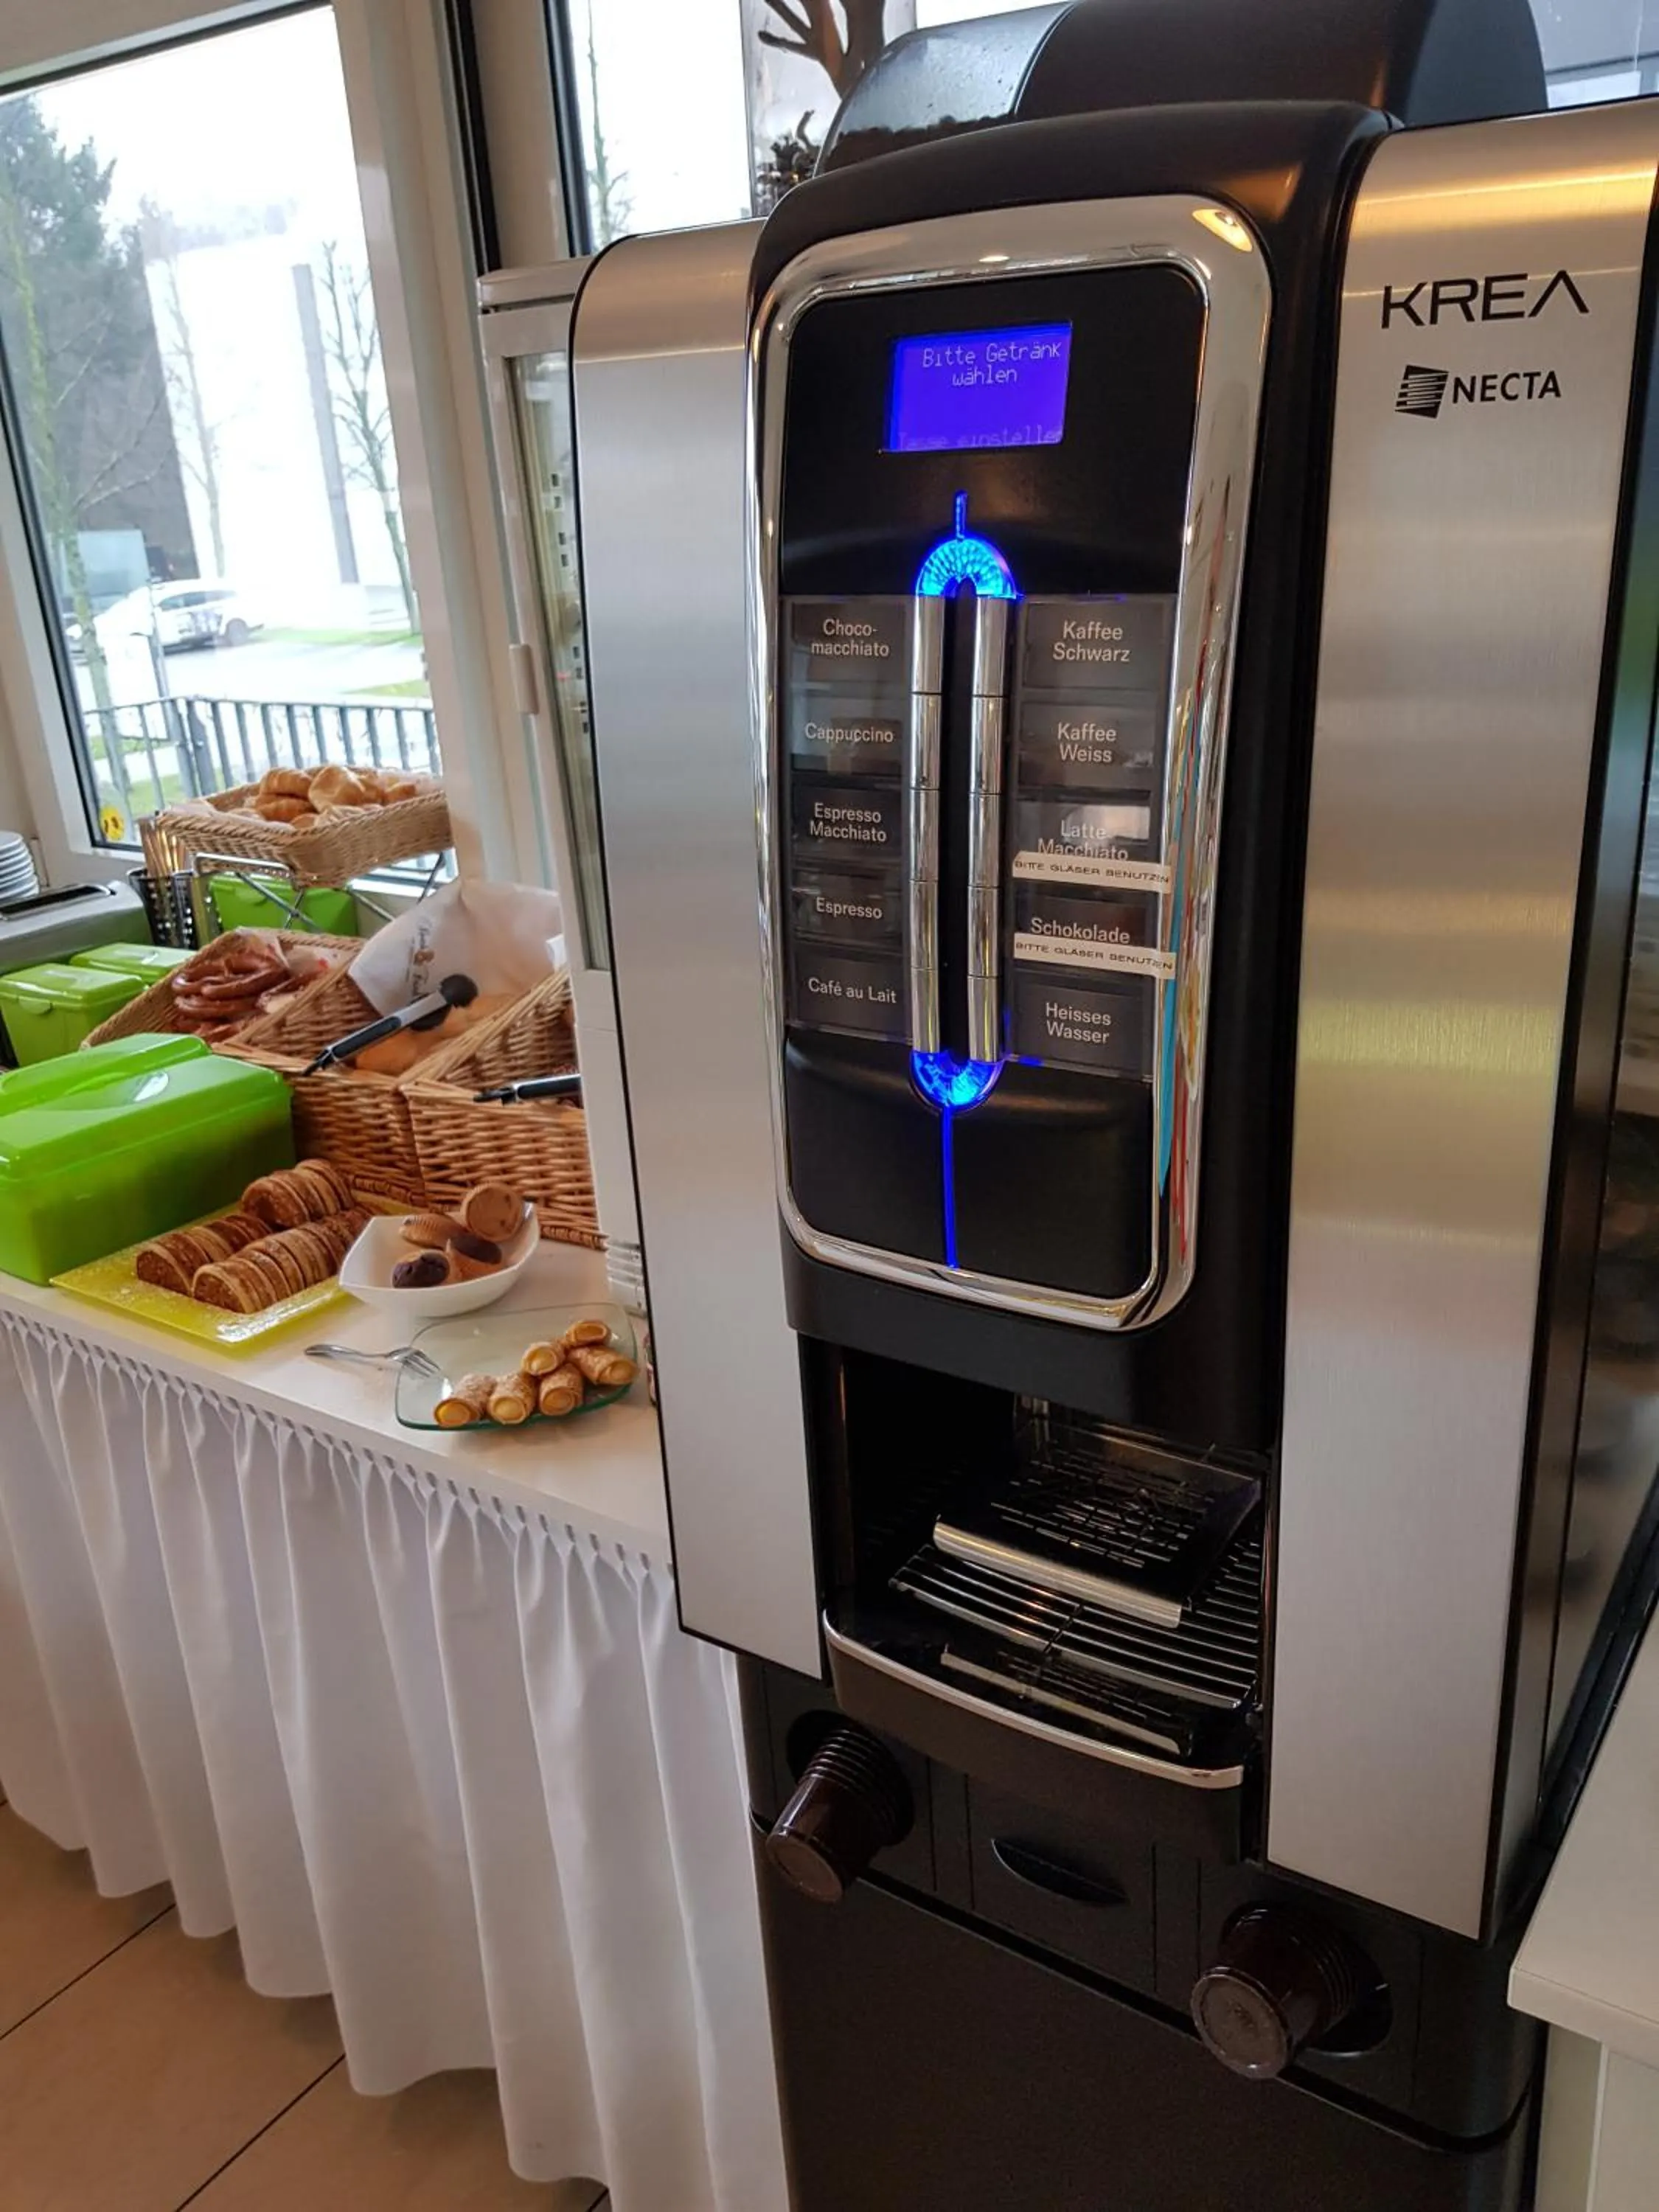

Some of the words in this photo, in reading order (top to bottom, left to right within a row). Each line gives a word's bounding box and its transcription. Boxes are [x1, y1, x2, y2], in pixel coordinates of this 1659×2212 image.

[922, 346, 975, 368] Bitte
[986, 342, 1062, 362] Getränk
[952, 364, 1018, 386] wählen
[1453, 370, 1562, 404] NECTA
[823, 619, 877, 636] Choco-
[1062, 620, 1123, 640] Kaffee
[810, 639, 890, 657] macchiato
[1052, 642, 1130, 662] Schwarz
[804, 722, 894, 743] Cappuccino
[1057, 722, 1117, 742] Kaffee
[1059, 743, 1112, 762] Weiss
[814, 801, 882, 824] Espresso
[810, 820, 887, 843] Macchiato
[1061, 819, 1106, 839] Latte
[1037, 838, 1129, 861] Macchiato
[1015, 860, 1045, 871] BITTE
[815, 897, 883, 919] Espresso
[1030, 917, 1130, 945] Schokolade
[808, 977, 842, 996] Café
[846, 987, 863, 1000] au
[869, 986, 897, 1004] Lait
[1046, 1002, 1112, 1026] Heisses
[1046, 1020, 1110, 1044] Wasser
